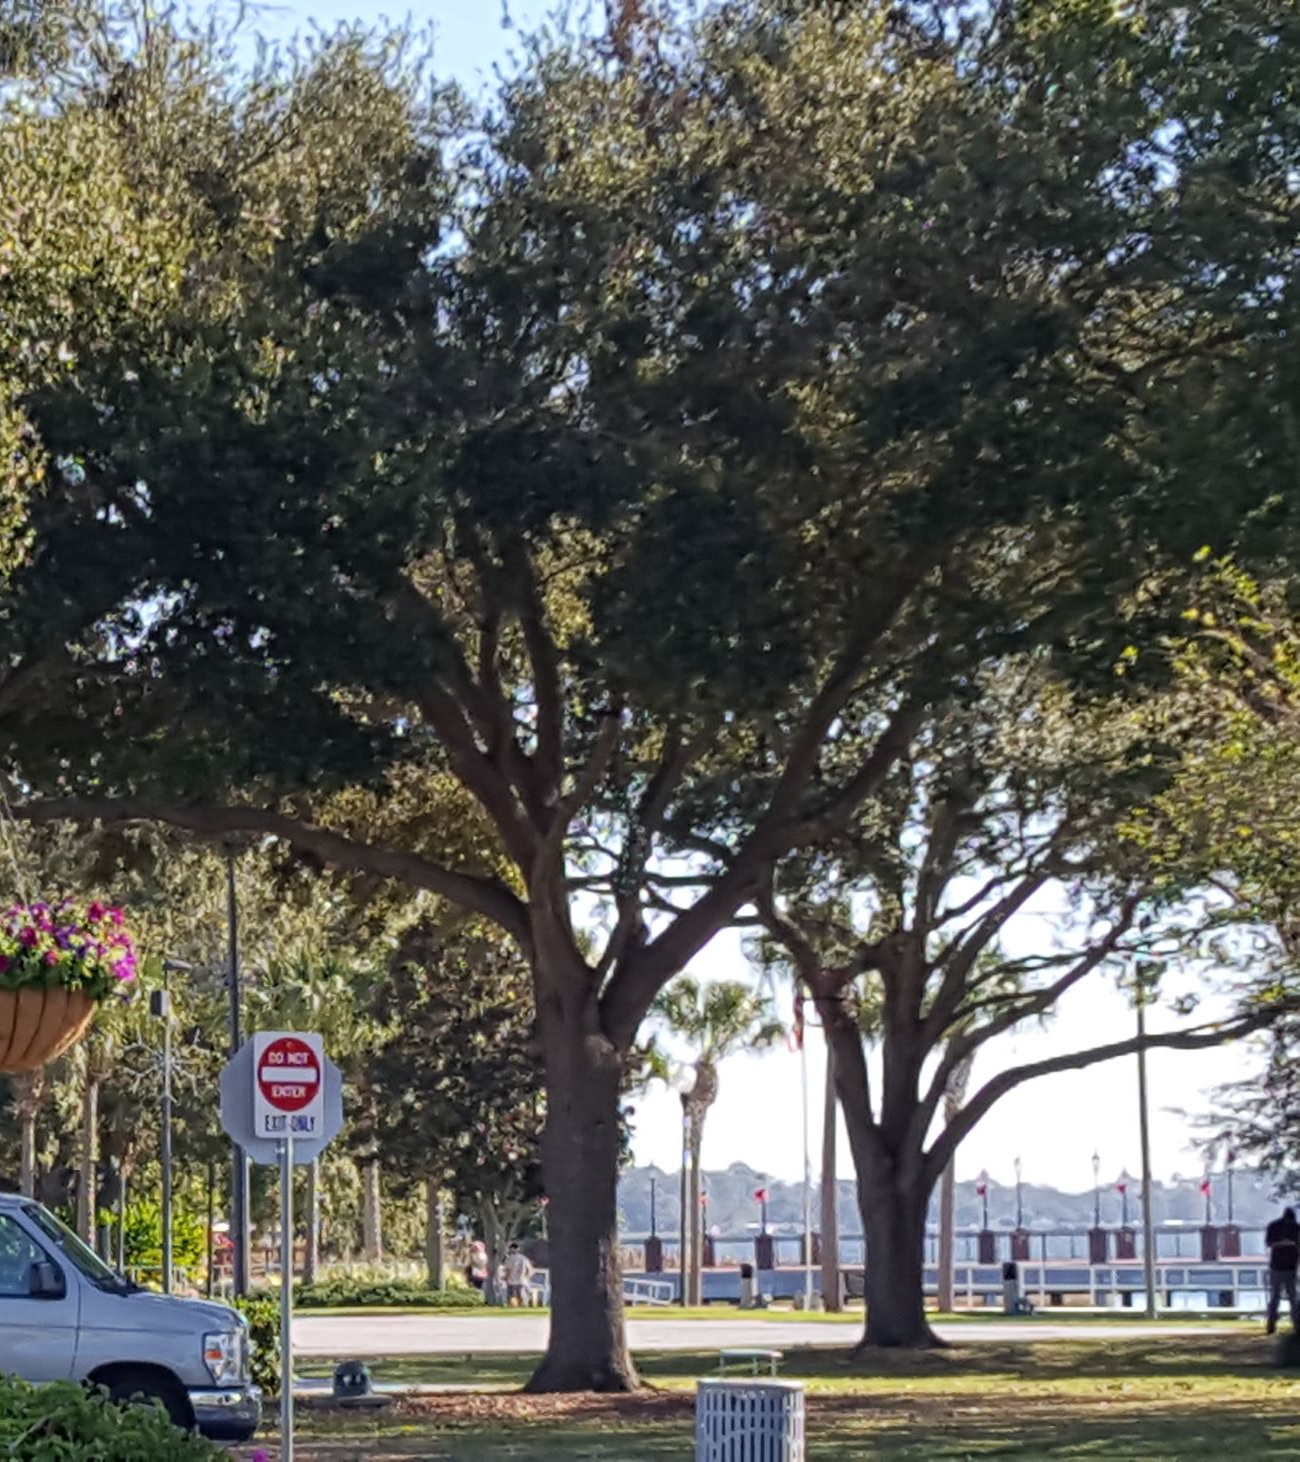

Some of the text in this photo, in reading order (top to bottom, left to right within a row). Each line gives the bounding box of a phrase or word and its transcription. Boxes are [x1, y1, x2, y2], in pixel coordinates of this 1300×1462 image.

[268, 1051, 310, 1065] DO NOT
[271, 1084, 307, 1098] ENTER
[265, 1115, 316, 1132] EXIT ONLY
